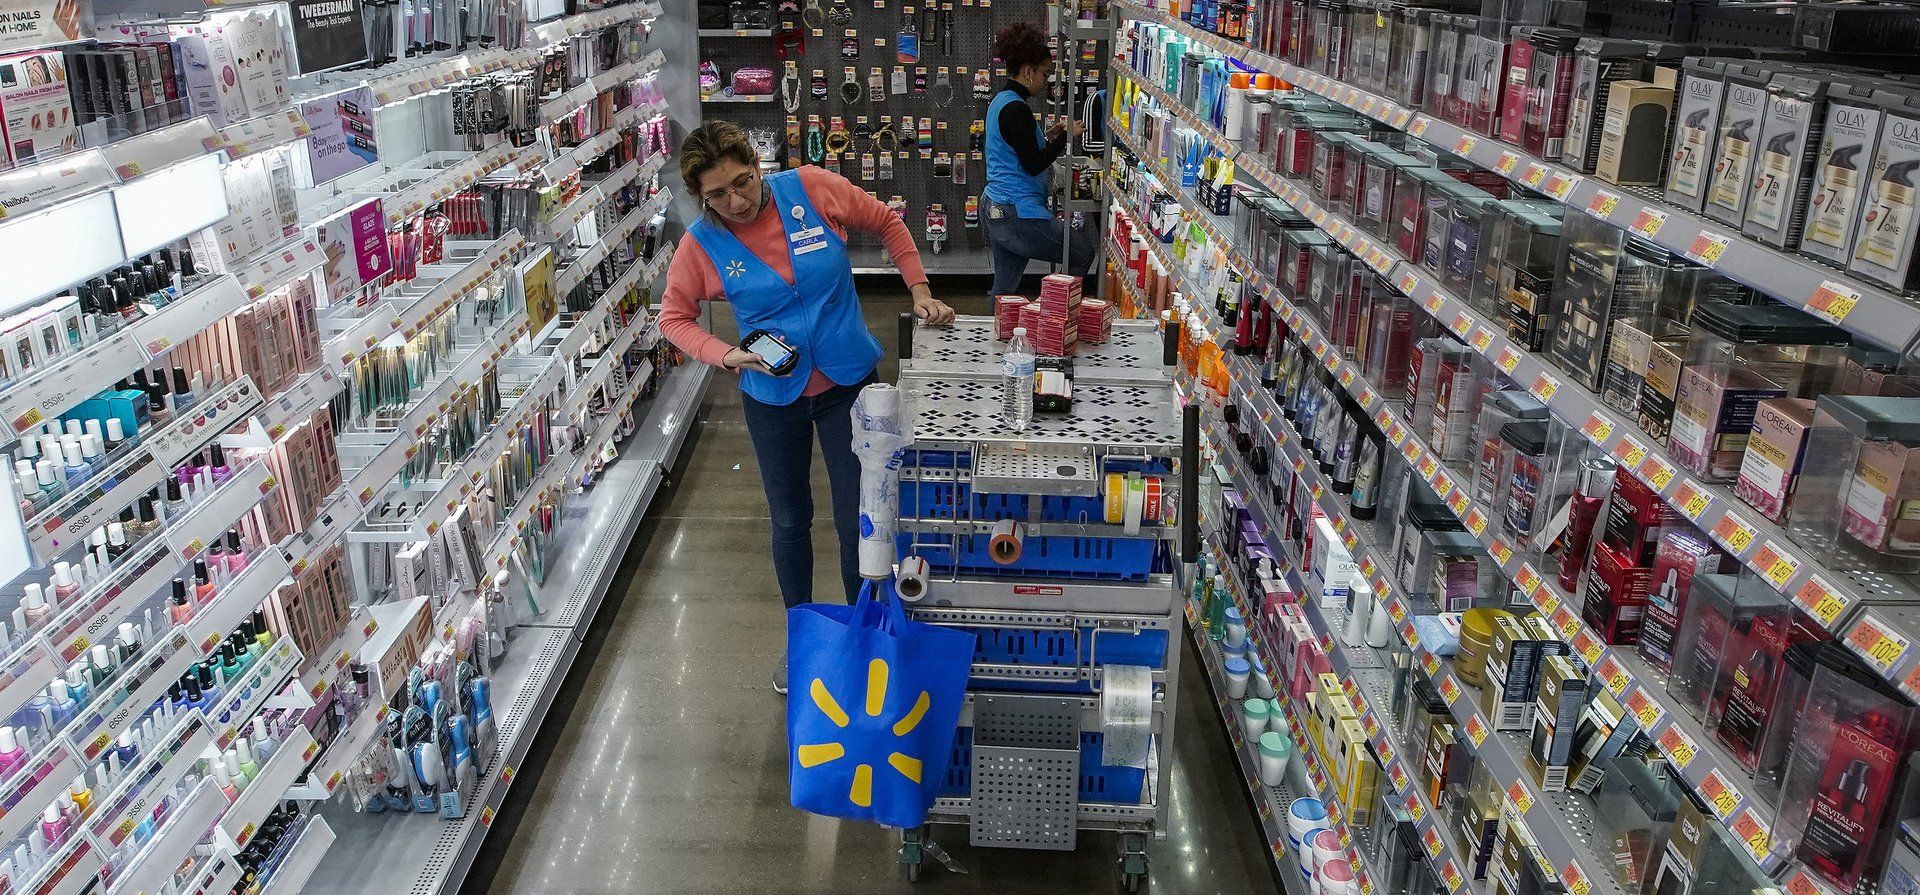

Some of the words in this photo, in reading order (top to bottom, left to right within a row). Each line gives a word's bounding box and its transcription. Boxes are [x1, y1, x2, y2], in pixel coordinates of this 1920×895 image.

[12, 11, 41, 21] NAILS
[299, 0, 354, 18] TWEEZERMAN
[9, 22, 38, 33] HOME
[307, 20, 316, 28] The
[316, 18, 329, 28] Beauty
[1600, 62, 1612, 78] 7
[6, 92, 22, 100] SALON
[1690, 80, 1714, 96] OLAY
[1734, 88, 1758, 105] OLAY
[1774, 100, 1800, 117] OLAY
[1836, 110, 1868, 128] OLAY
[1832, 127, 1847, 136] TOTAL
[1848, 130, 1866, 138] EFFECTS
[1892, 122, 1920, 142] OLA
[1888, 139, 1903, 148] TOTAL
[1682, 146, 1692, 168] 7
[1688, 161, 1697, 169] ONE
[1875, 160, 1886, 171] 30
[1724, 158, 1734, 180] 7
[1729, 172, 1740, 182] ONE
[1764, 174, 1776, 197] 7
[1, 195, 30, 209] Nailboo
[1824, 188, 1838, 214] 7
[1836, 194, 1842, 204] IN
[1831, 204, 1846, 216] ONE
[1877, 206, 1892, 232] 7
[1890, 214, 1898, 224] IN
[1884, 224, 1900, 236] ONE
[798, 237, 818, 246] CARLA
[42, 392, 65, 410] essie
[1750, 436, 1762, 446] AGE
[1762, 440, 1786, 461] PERFECT
[68, 515, 90, 534] essie
[450, 522, 460, 552] BROWS
[1770, 560, 1792, 580] 1497
[1648, 604, 1678, 626] REVITALIFT
[1816, 598, 1842, 618] 1497
[88, 614, 108, 634] essie
[1562, 620, 1578, 635] 997
[1754, 624, 1784, 652] L'OREA
[1872, 640, 1900, 662] 1012
[1610, 676, 1626, 690] 997
[1732, 686, 1767, 716] REVITALIFT
[109, 708, 128, 730] essie
[1638, 706, 1657, 724] 2197
[1672, 744, 1692, 764] 2197
[1840, 728, 1894, 764] L'OREAL
[1714, 790, 1736, 811] 2197
[1817, 801, 1864, 832] REVITALIFT
[1817, 807, 1833, 820] TRIPLE
[1834, 816, 1854, 832] POWER
[1814, 816, 1841, 836] ANTI-AGING
[1842, 832, 1858, 846] SERUM
